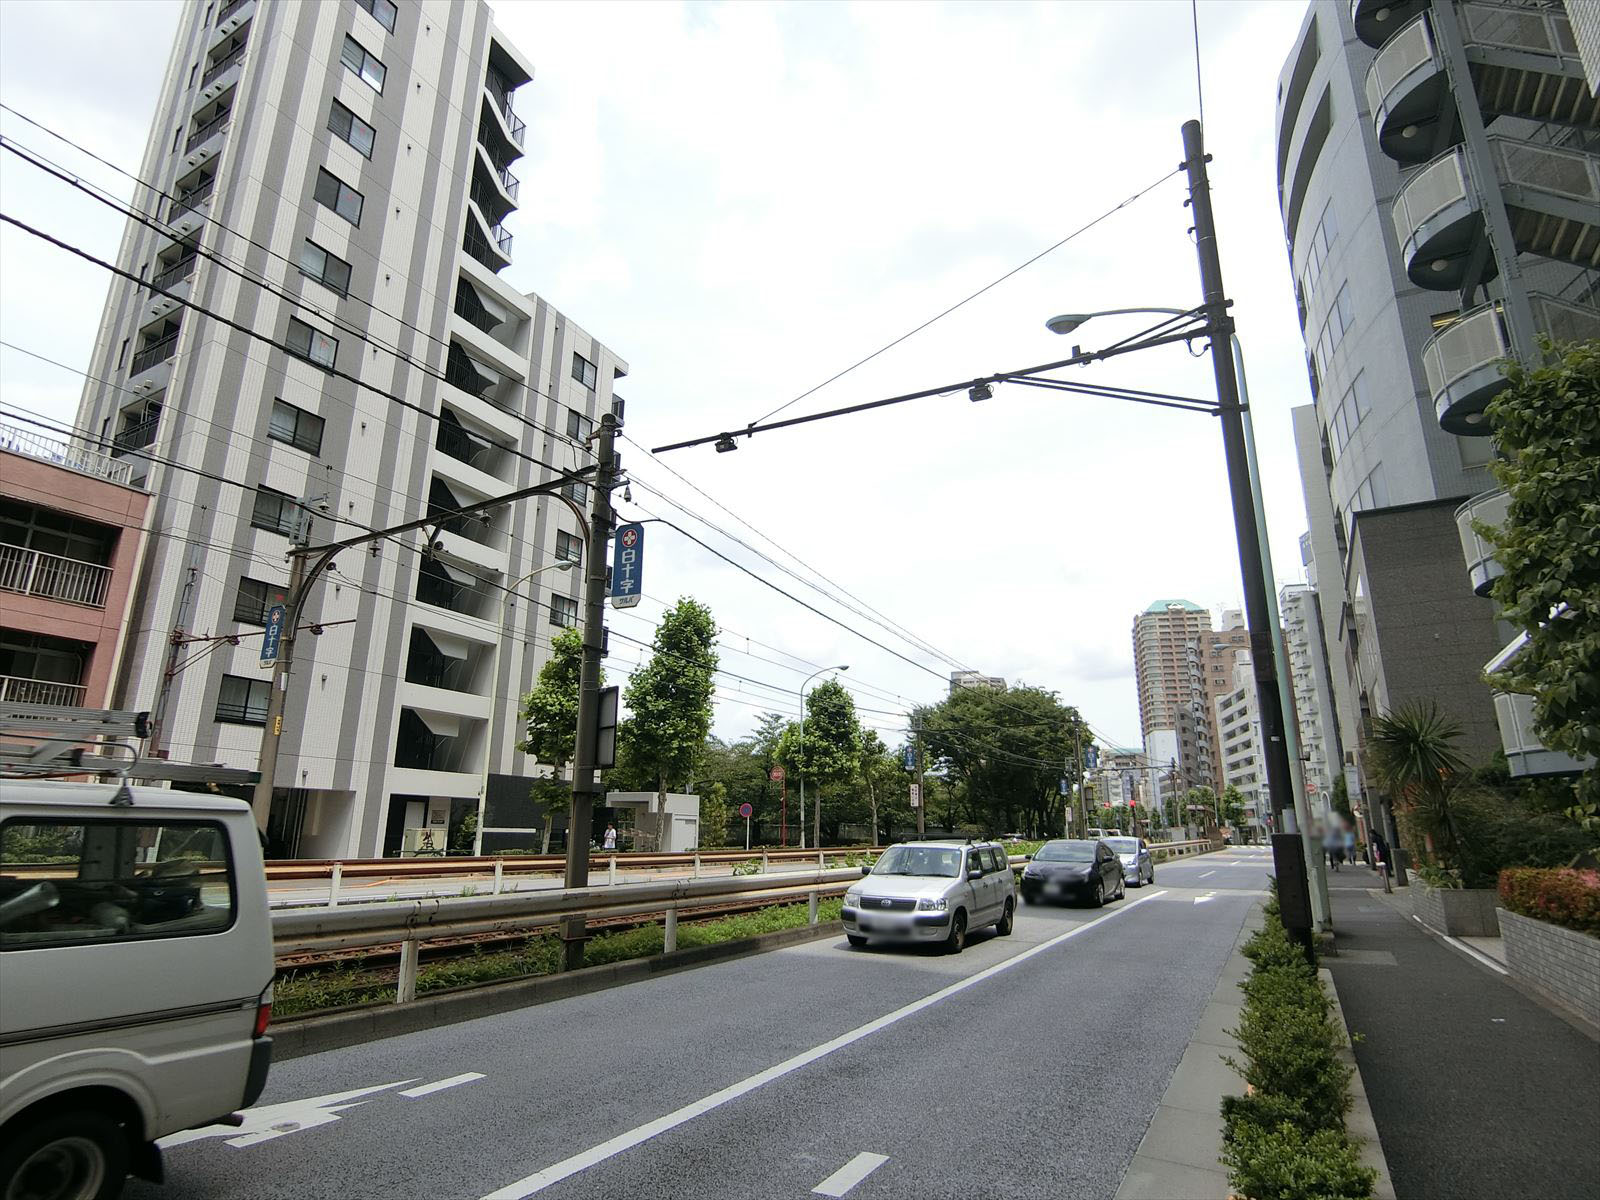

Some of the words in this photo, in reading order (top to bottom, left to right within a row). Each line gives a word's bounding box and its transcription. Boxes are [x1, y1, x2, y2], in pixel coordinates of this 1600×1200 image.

[620, 548, 636, 594] 白十字
[265, 625, 278, 658] 白十字
